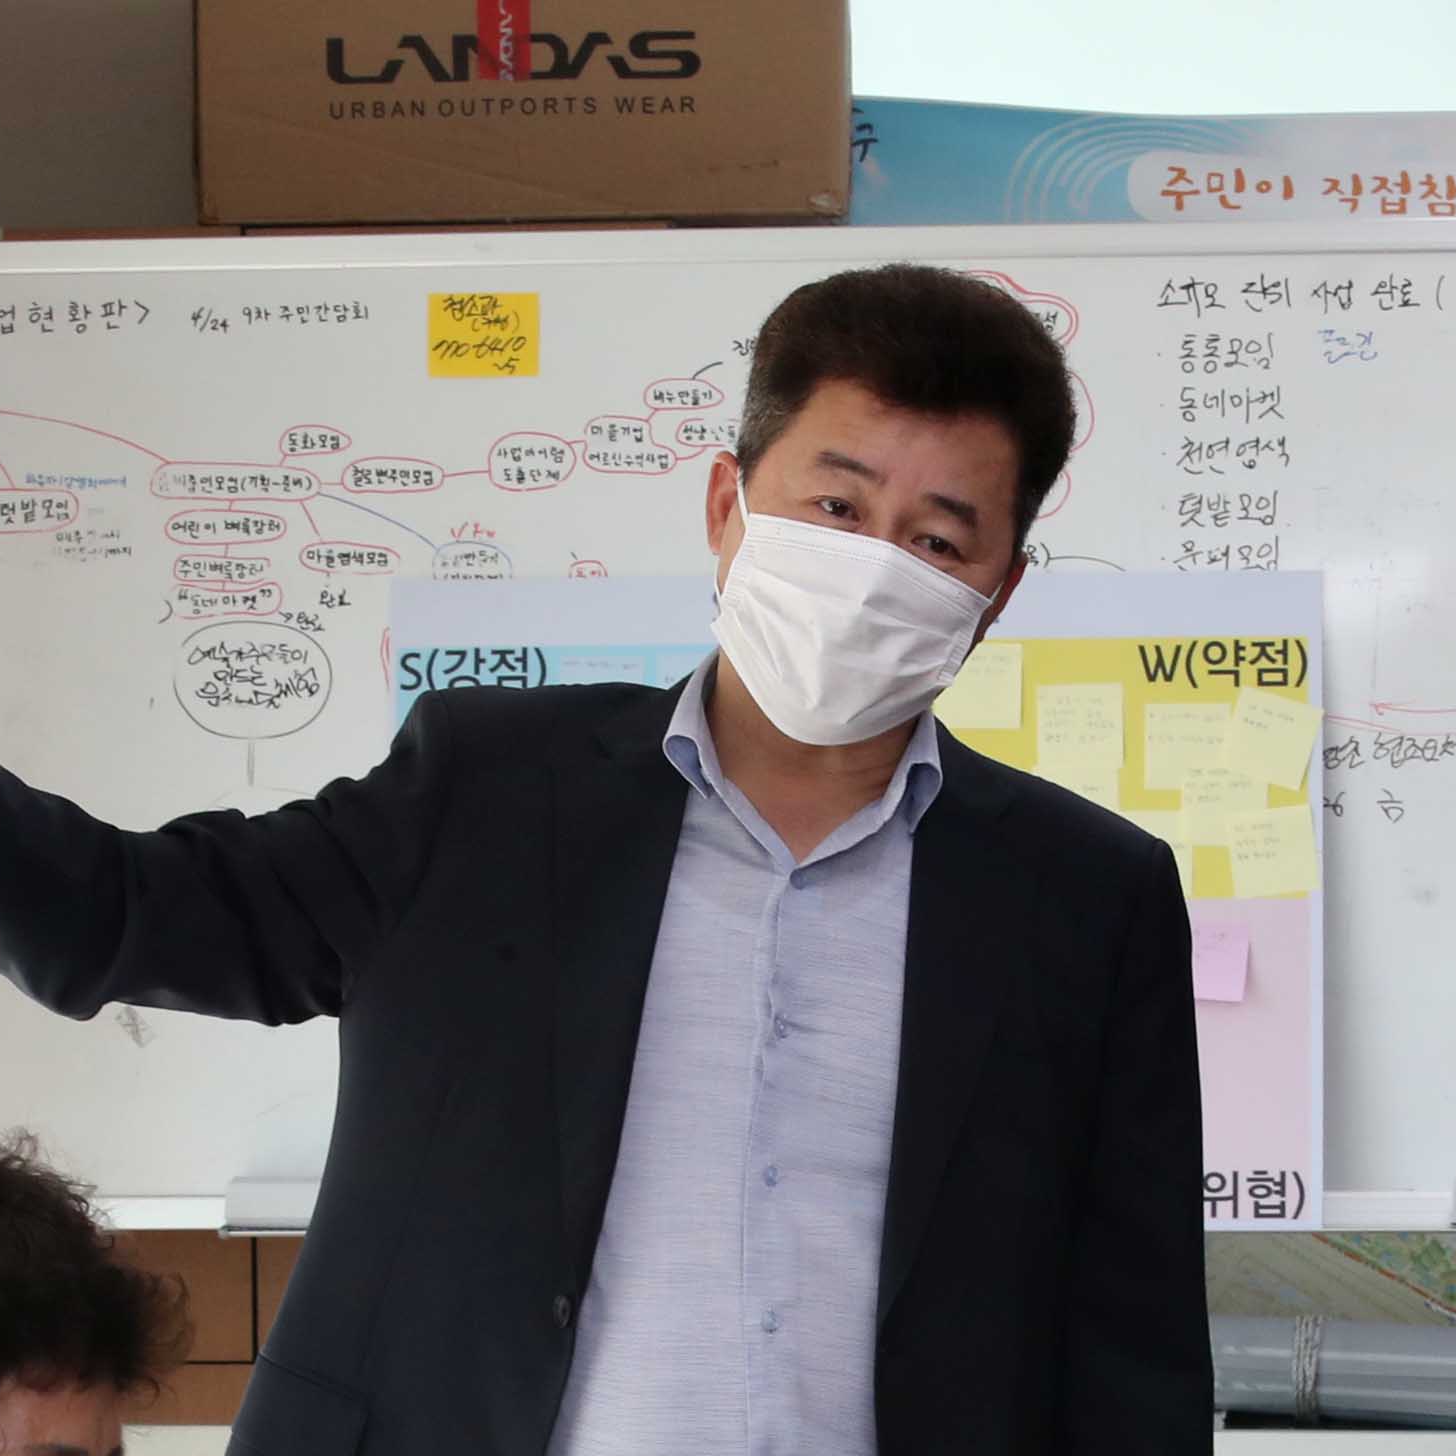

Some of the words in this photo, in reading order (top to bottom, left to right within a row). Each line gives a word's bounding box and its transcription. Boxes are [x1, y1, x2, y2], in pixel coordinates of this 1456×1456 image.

[329, 101, 425, 120] URBAN
[438, 97, 597, 117] OUTPORTS
[616, 96, 696, 114] WEAR
[1159, 164, 1296, 209] 주민이
[1138, 639, 1308, 688] W(약점)
